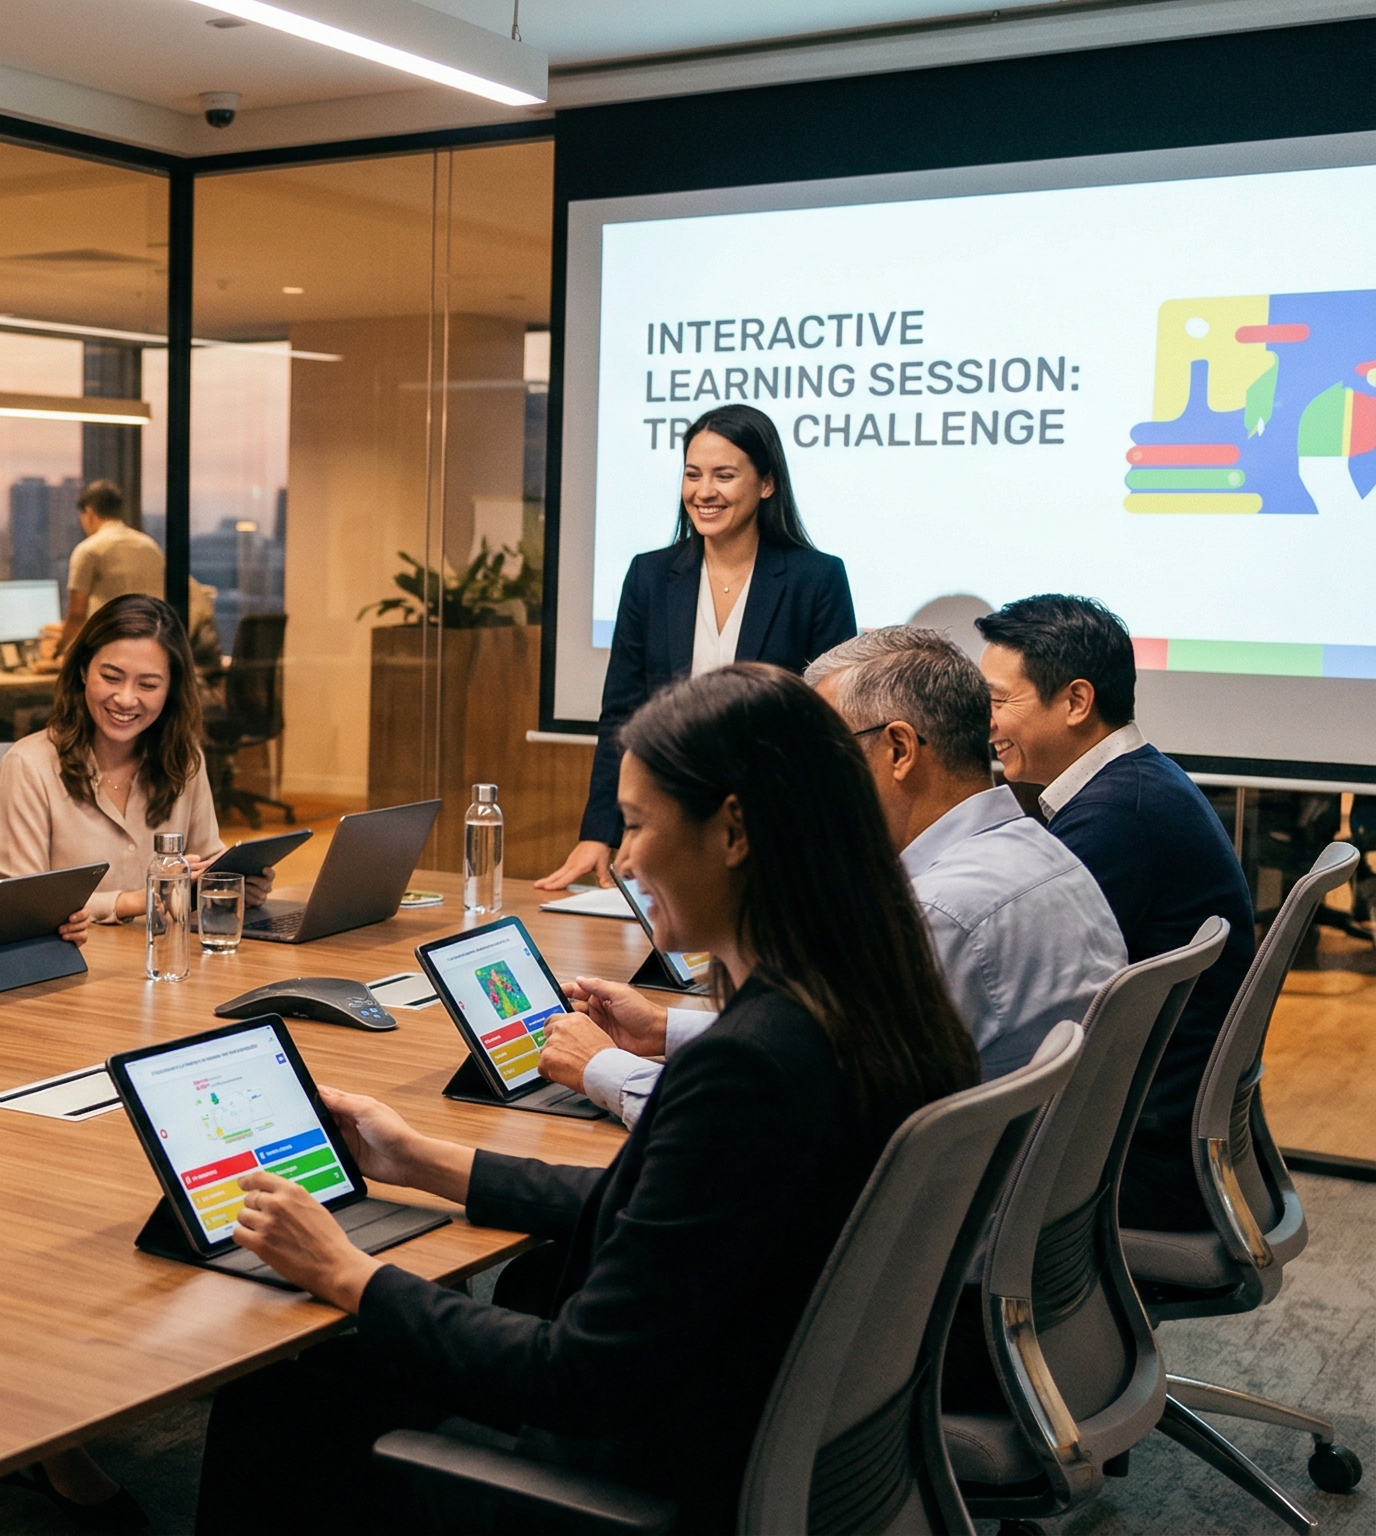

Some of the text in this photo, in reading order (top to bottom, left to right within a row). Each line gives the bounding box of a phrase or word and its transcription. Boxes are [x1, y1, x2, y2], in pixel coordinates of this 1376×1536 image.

[647, 311, 924, 355] INTERACTIVE
[645, 356, 1080, 402] LEARNING SESSION:
[793, 409, 1065, 448] CHALLENGE
